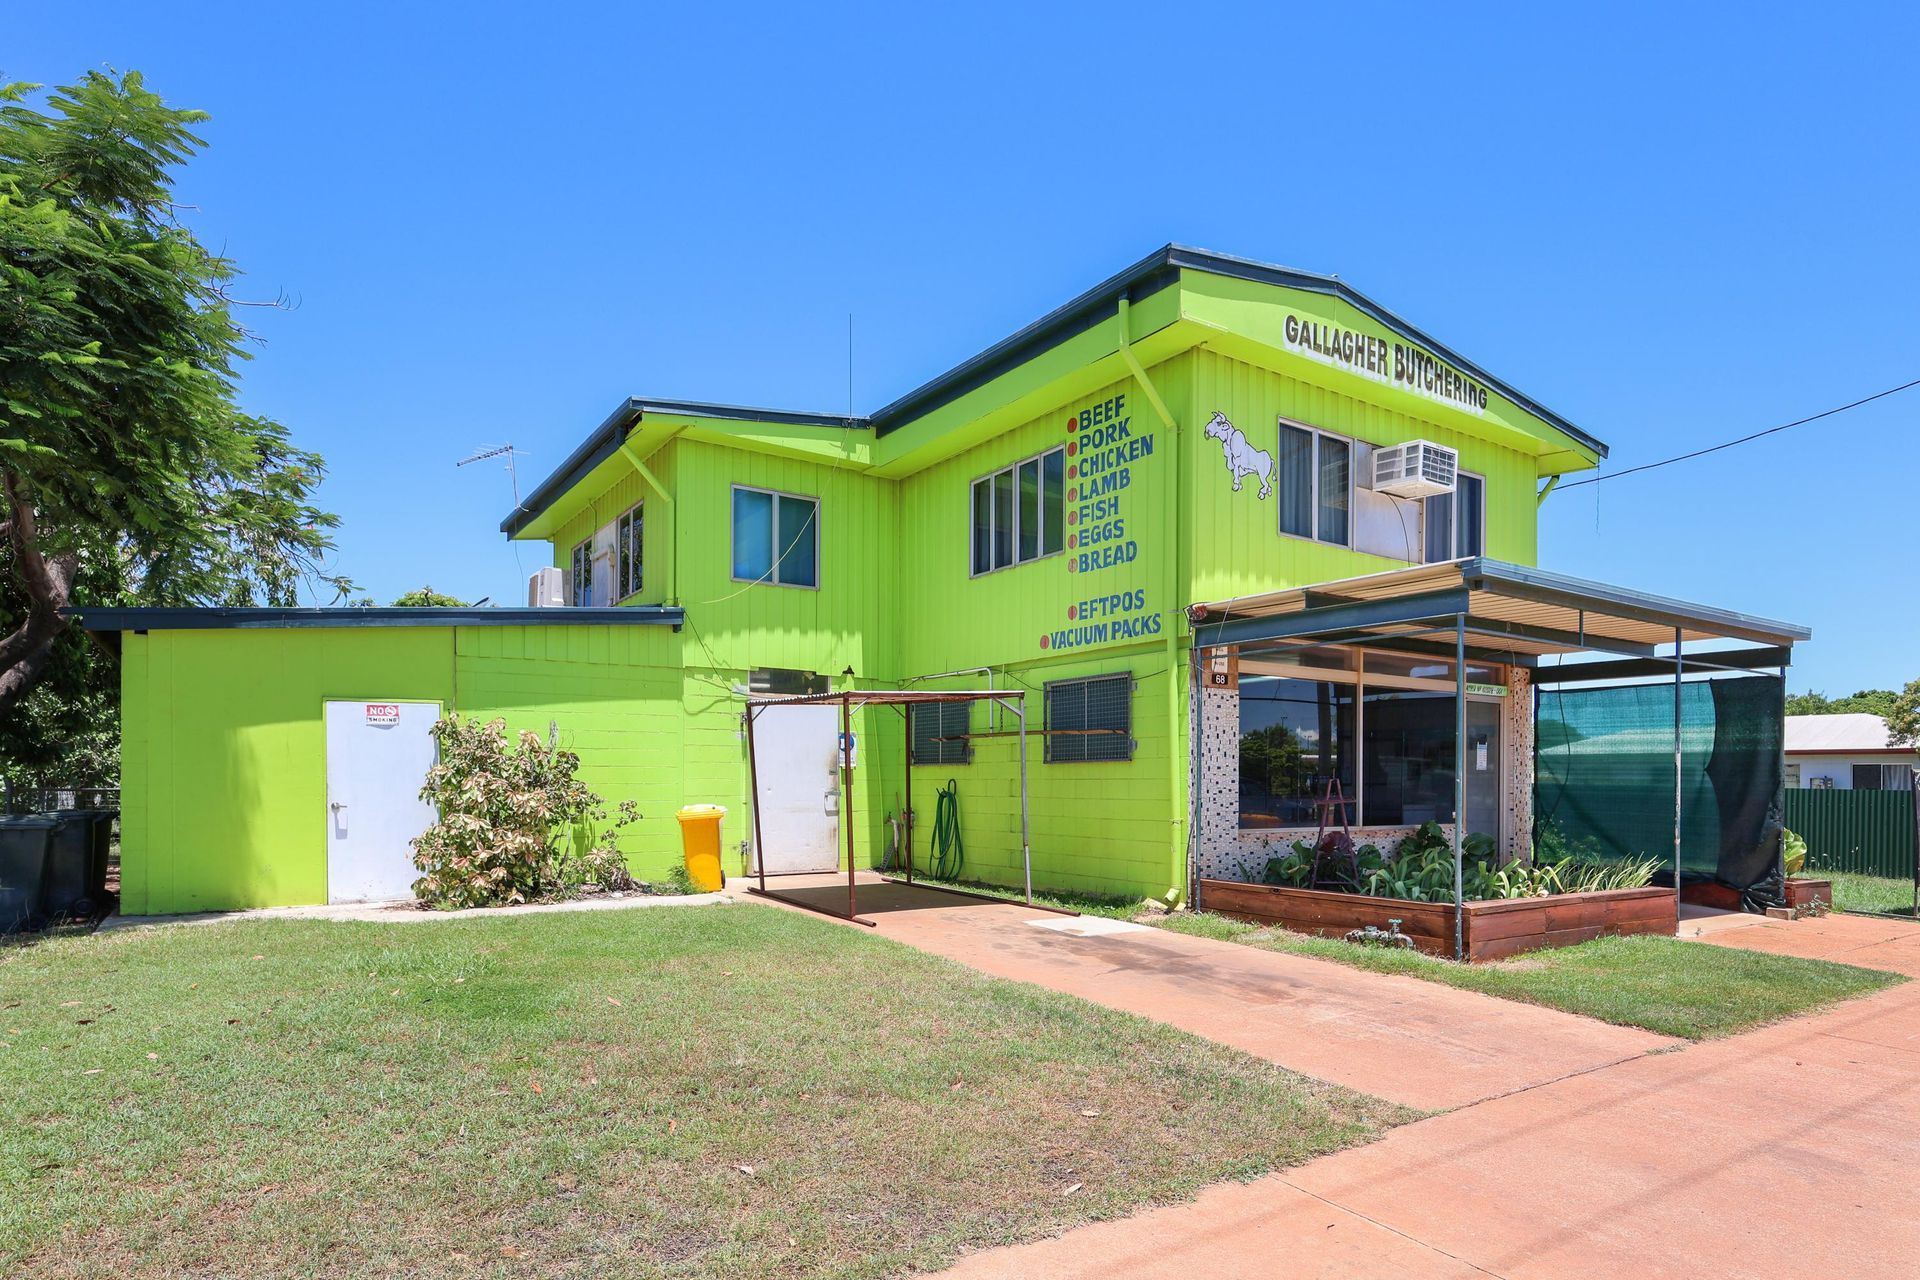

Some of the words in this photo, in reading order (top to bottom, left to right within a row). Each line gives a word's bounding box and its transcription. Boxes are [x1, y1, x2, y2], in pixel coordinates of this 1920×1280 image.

[1285, 315, 1388, 377] GALLAGHER
[1079, 394, 1125, 432] BEEF
[1079, 416, 1131, 455] PORK
[1079, 433, 1154, 479] CHICKEN
[1079, 467, 1131, 502] LAMB
[1079, 496, 1119, 525] FISH
[1078, 518, 1124, 547] EGGS
[1078, 540, 1137, 574] BREAD
[1078, 589, 1145, 620] EFTPOS
[1050, 621, 1108, 650] VACUUM
[1111, 613, 1161, 641] PACKS
[1215, 674, 1226, 685] 68
[369, 706, 384, 715] NO
